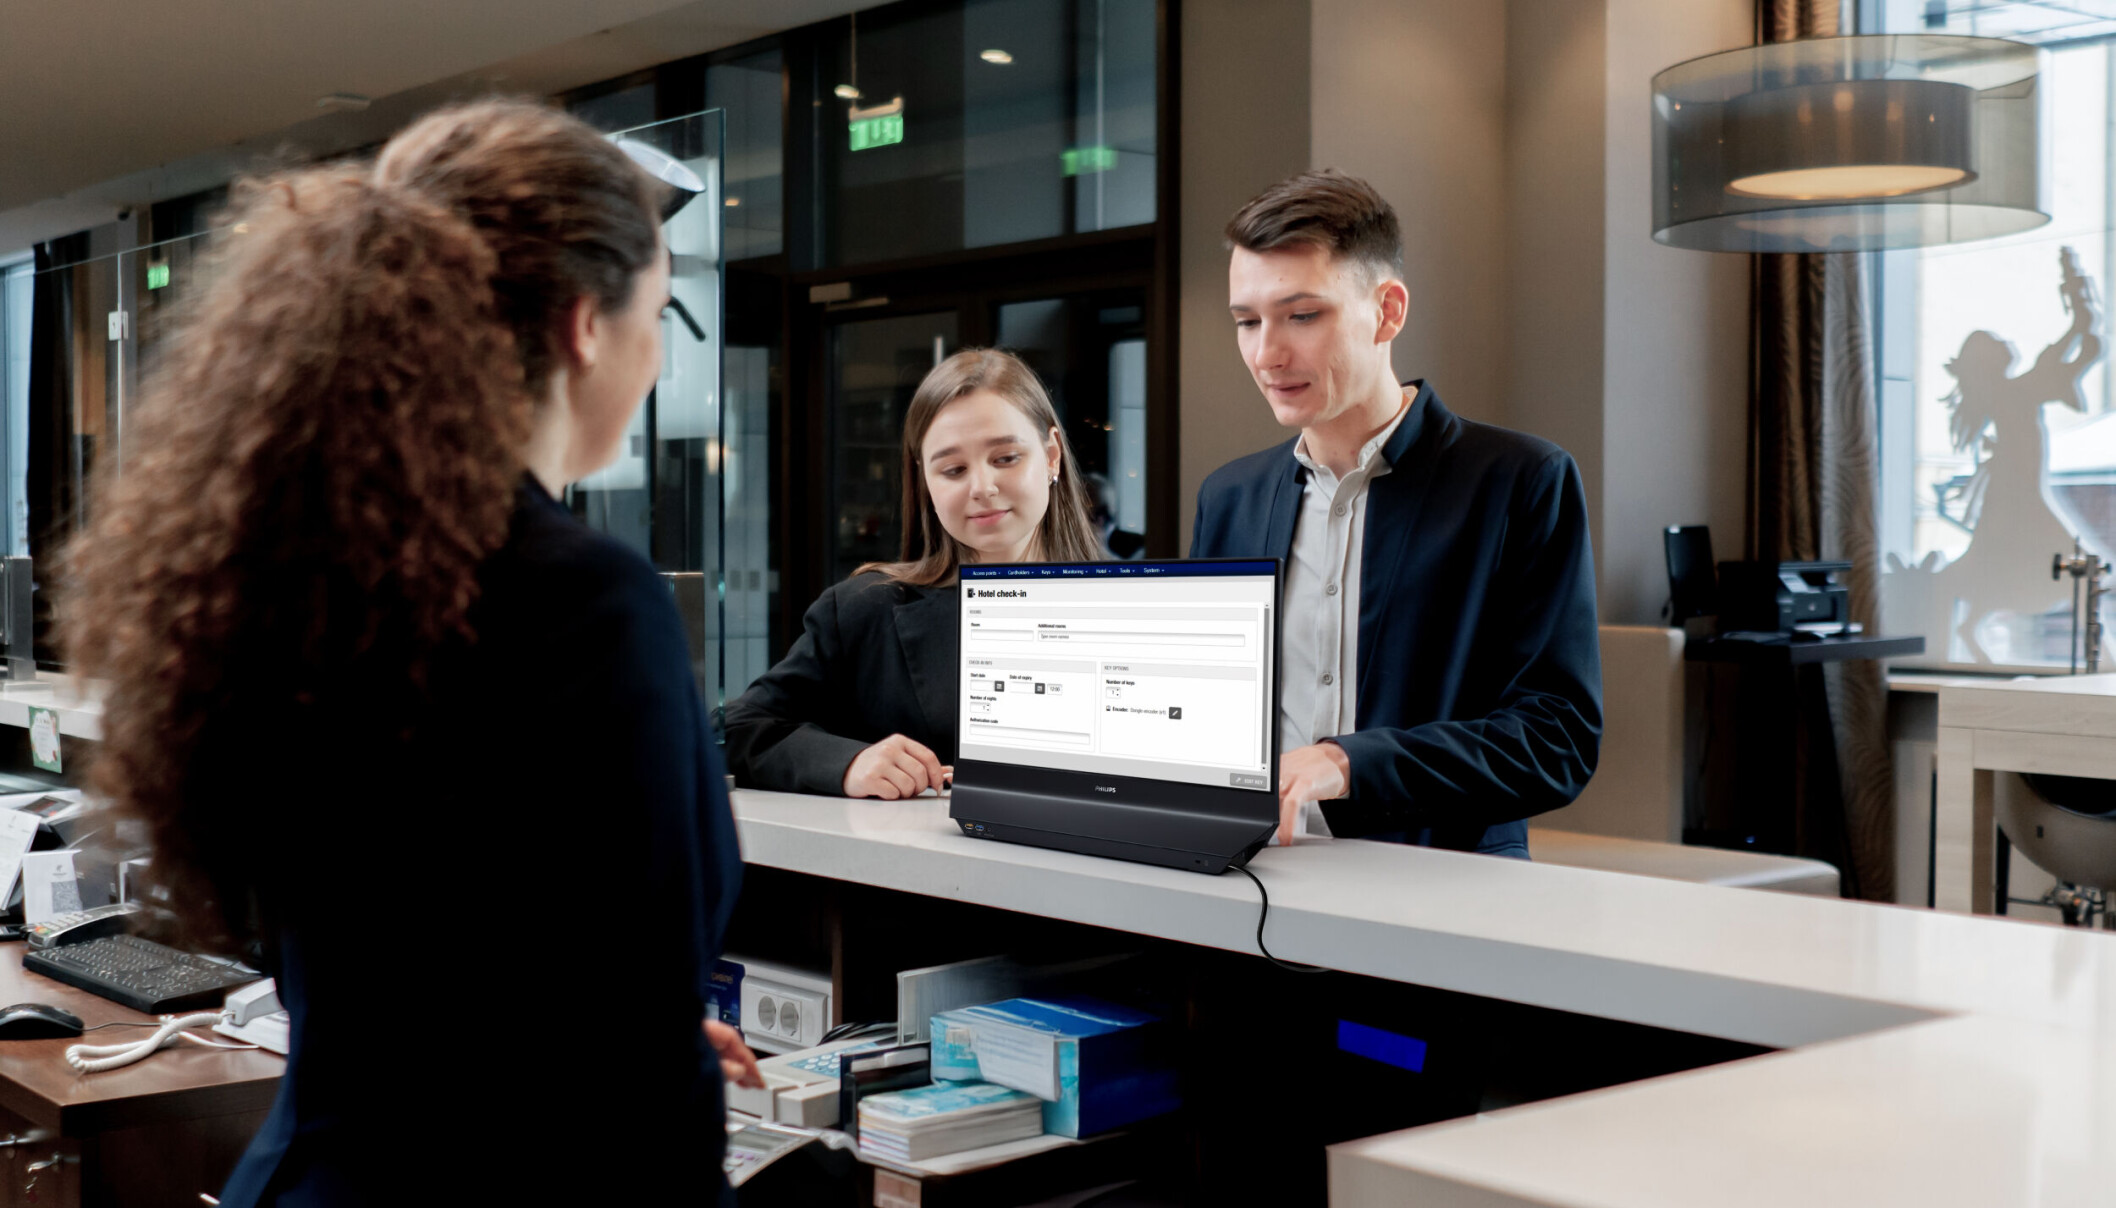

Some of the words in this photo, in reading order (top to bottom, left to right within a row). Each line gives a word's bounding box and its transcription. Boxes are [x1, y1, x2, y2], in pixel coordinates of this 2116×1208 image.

[978, 589, 995, 598] Hotel
[996, 589, 1027, 598] check-in
[1094, 785, 1116, 793] PHILIPS
